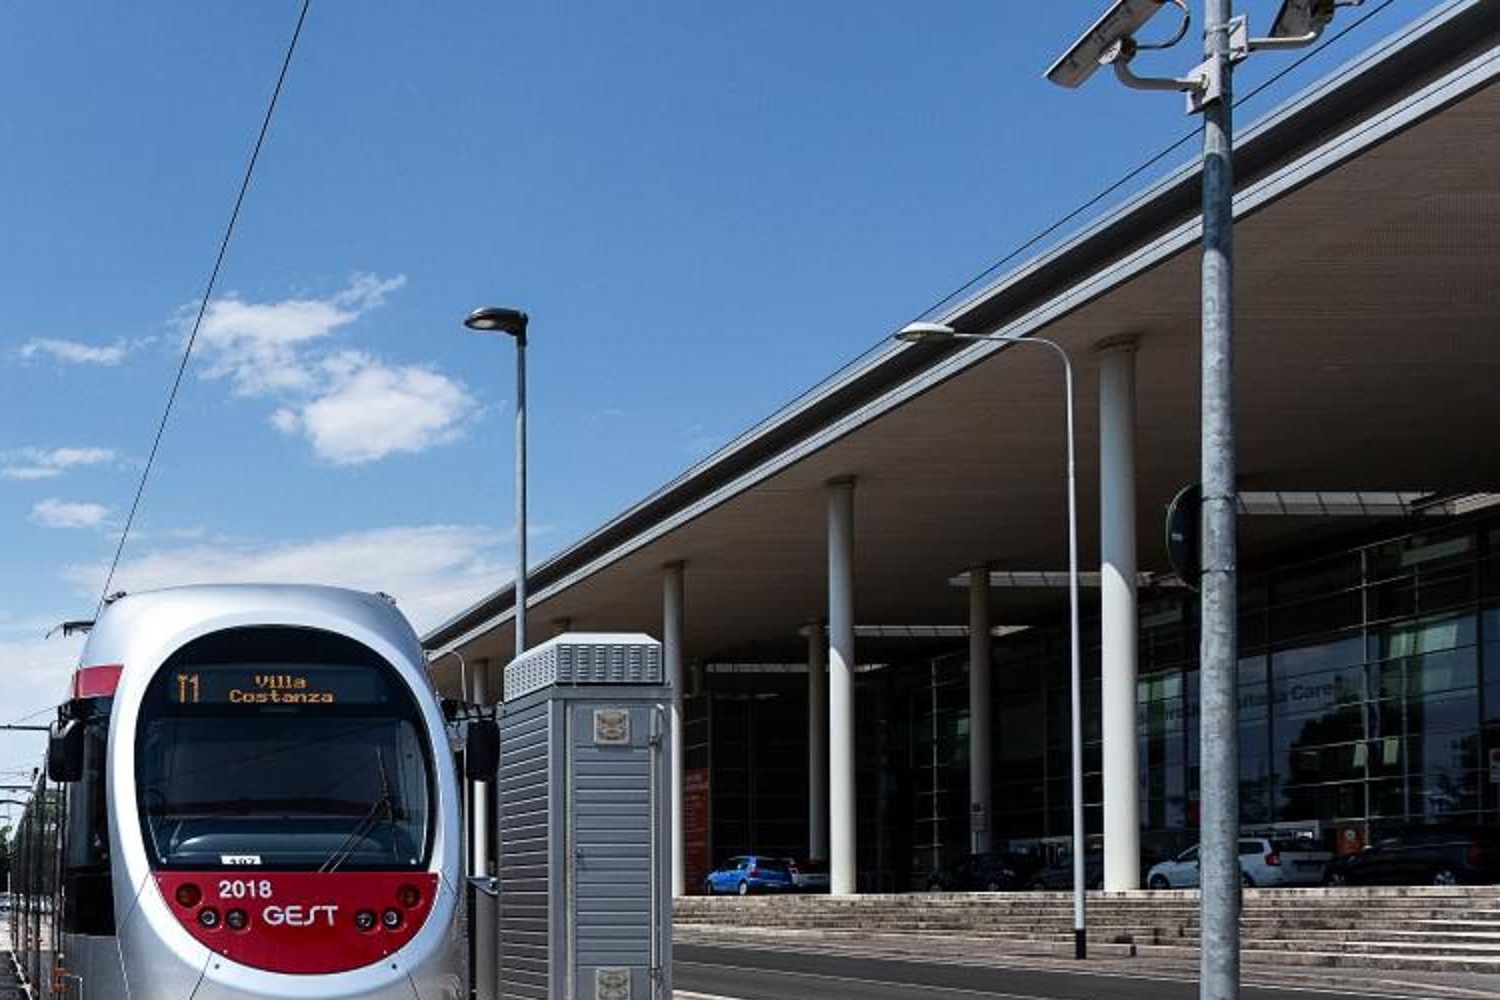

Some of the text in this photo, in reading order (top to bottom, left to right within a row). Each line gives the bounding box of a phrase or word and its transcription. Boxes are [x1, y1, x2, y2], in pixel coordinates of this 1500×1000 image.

[178, 673, 307, 702] T1 Villa
[229, 689, 333, 703] Costanza
[219, 880, 273, 898] 2018
[263, 905, 338, 926] GEST
